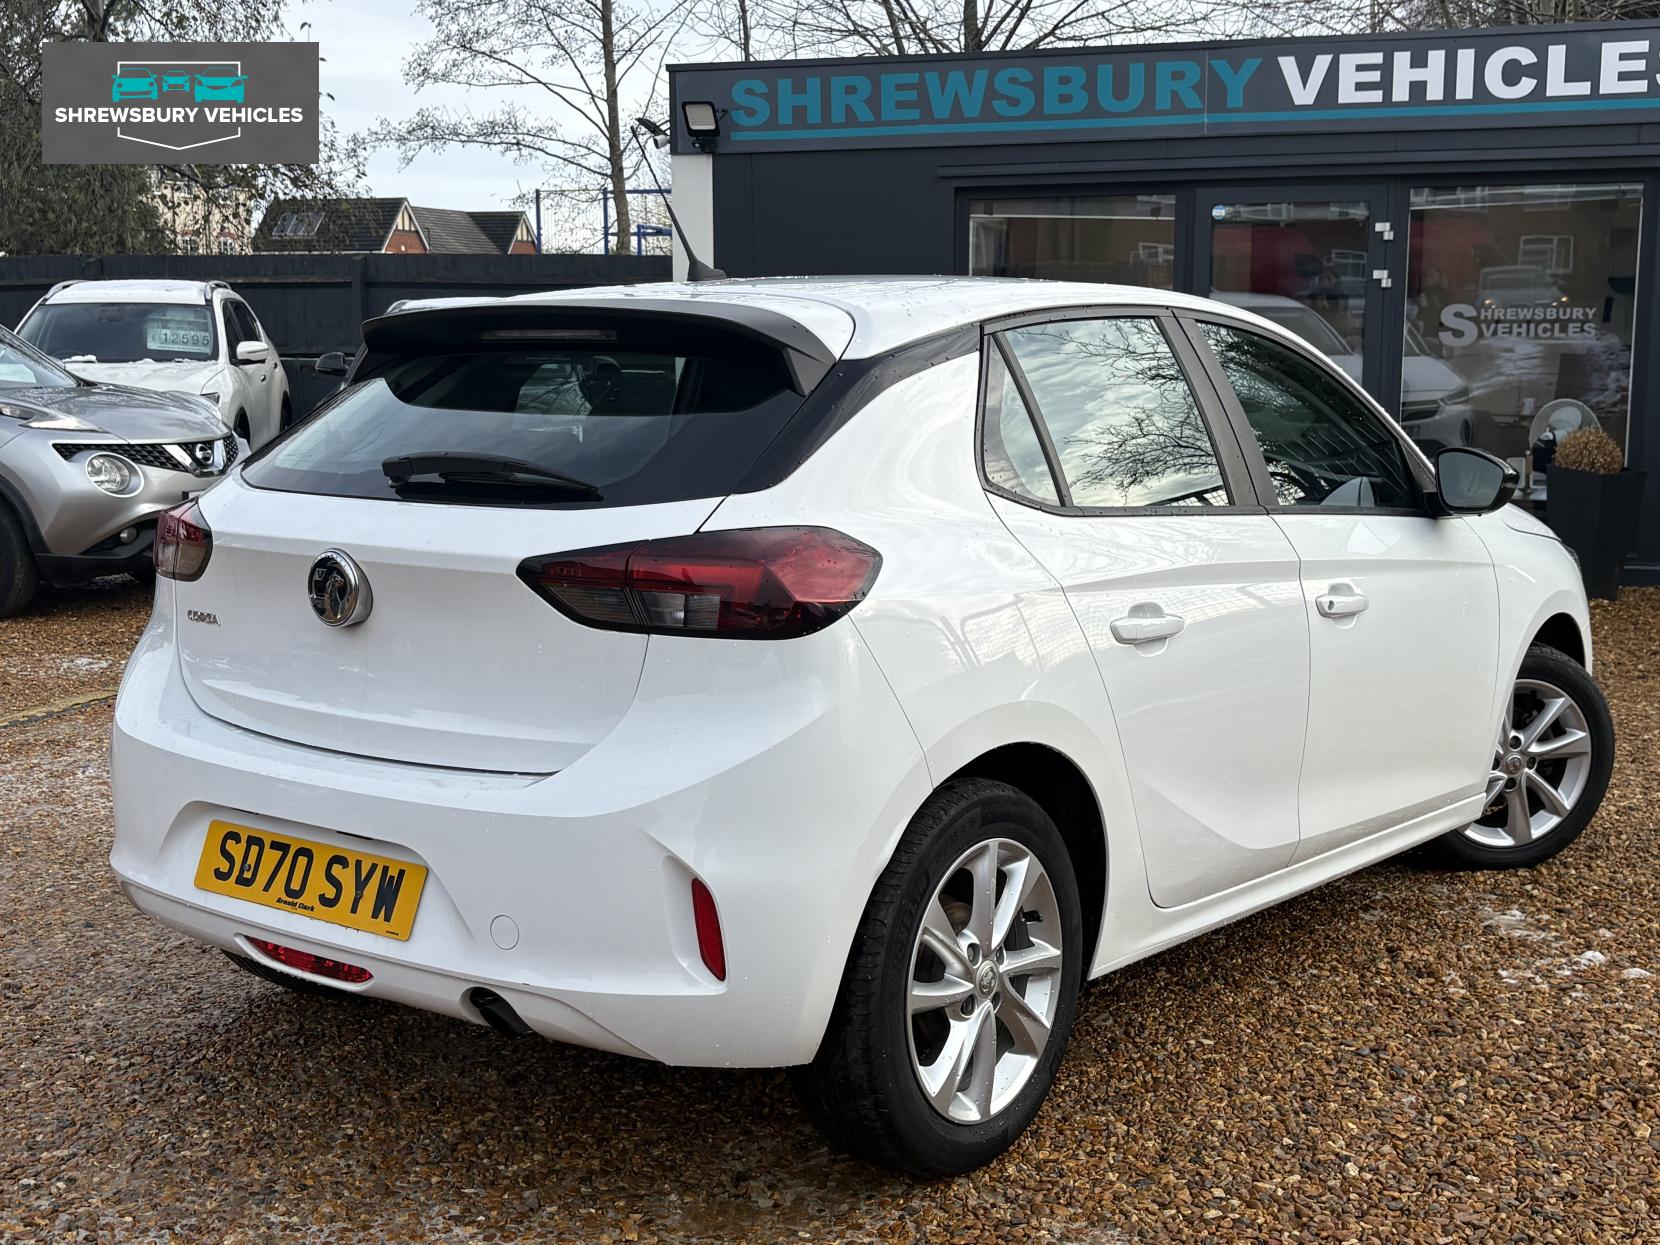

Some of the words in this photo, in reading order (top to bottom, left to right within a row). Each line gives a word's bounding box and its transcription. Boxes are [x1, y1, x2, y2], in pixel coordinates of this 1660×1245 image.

[731, 58, 1263, 127] SHREWSBURY
[1277, 40, 1660, 106] VEHICLE
[1481, 322, 1597, 338] VEHICLES
[213, 830, 314, 900] SD70
[318, 854, 406, 923] SYW
